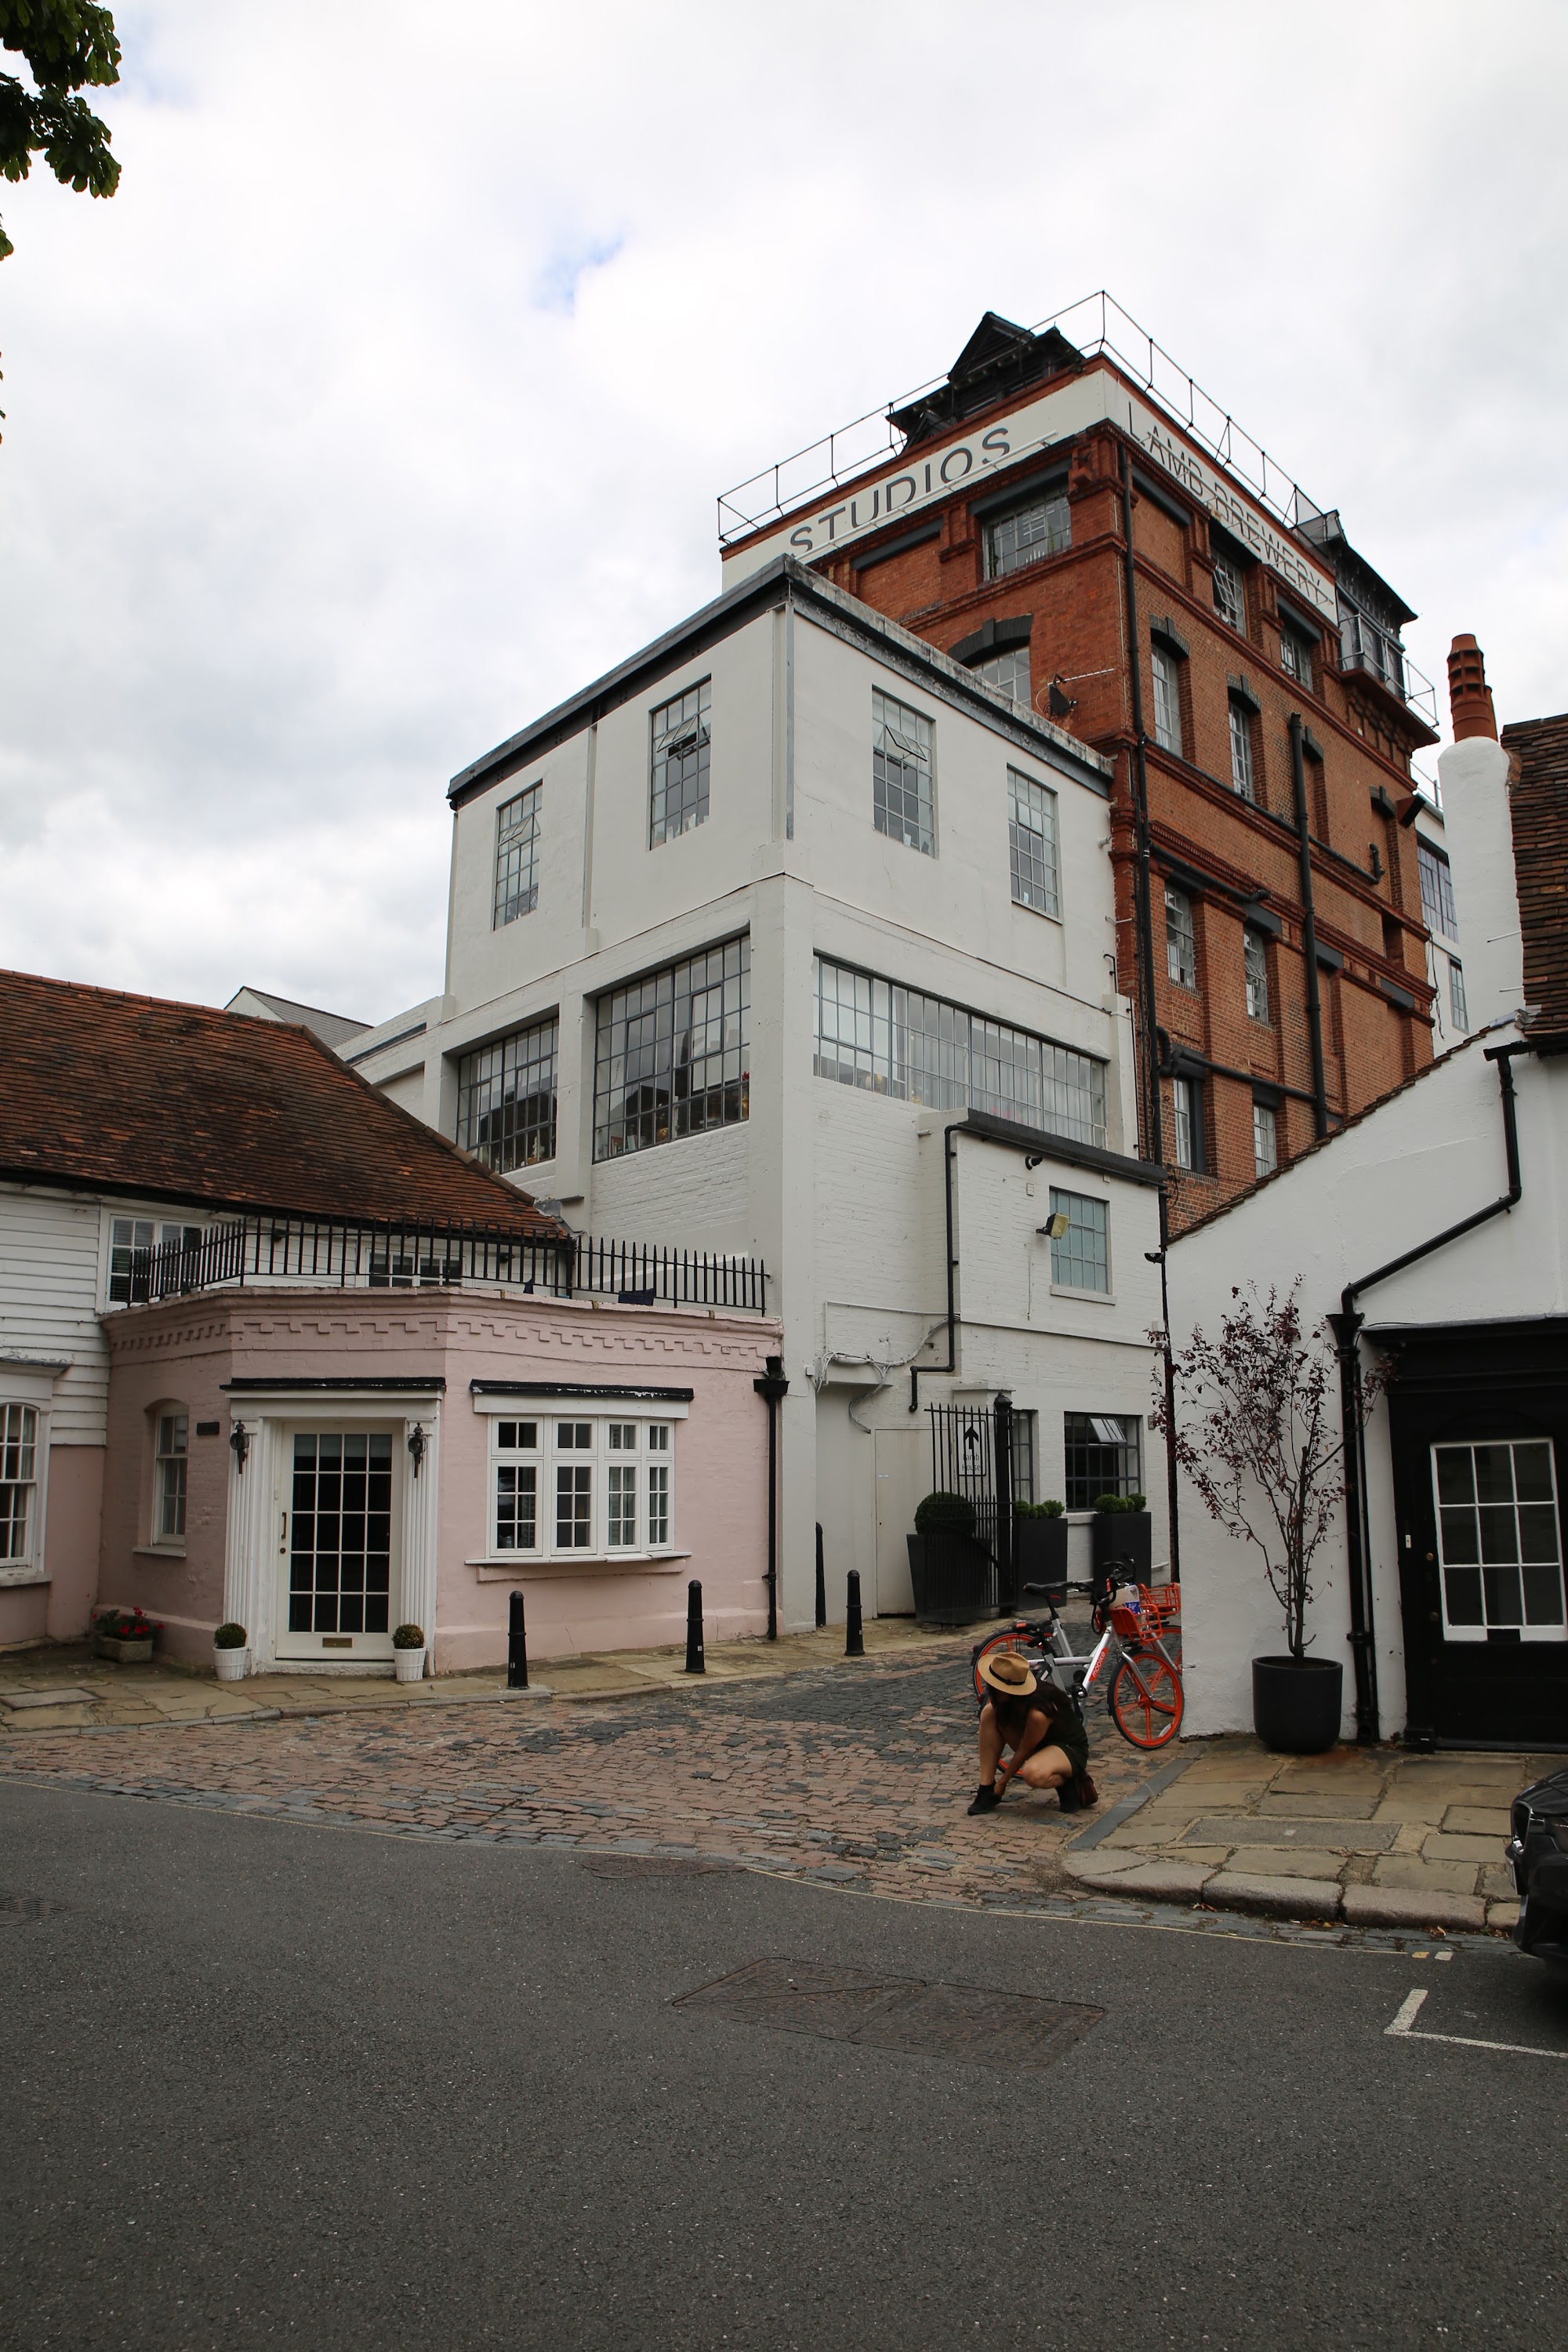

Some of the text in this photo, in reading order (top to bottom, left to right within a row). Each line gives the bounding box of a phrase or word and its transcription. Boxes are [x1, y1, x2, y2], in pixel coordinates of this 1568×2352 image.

[789, 427, 1011, 557] STUDIOS
[1129, 401, 1320, 604] LAMB BREWERY
